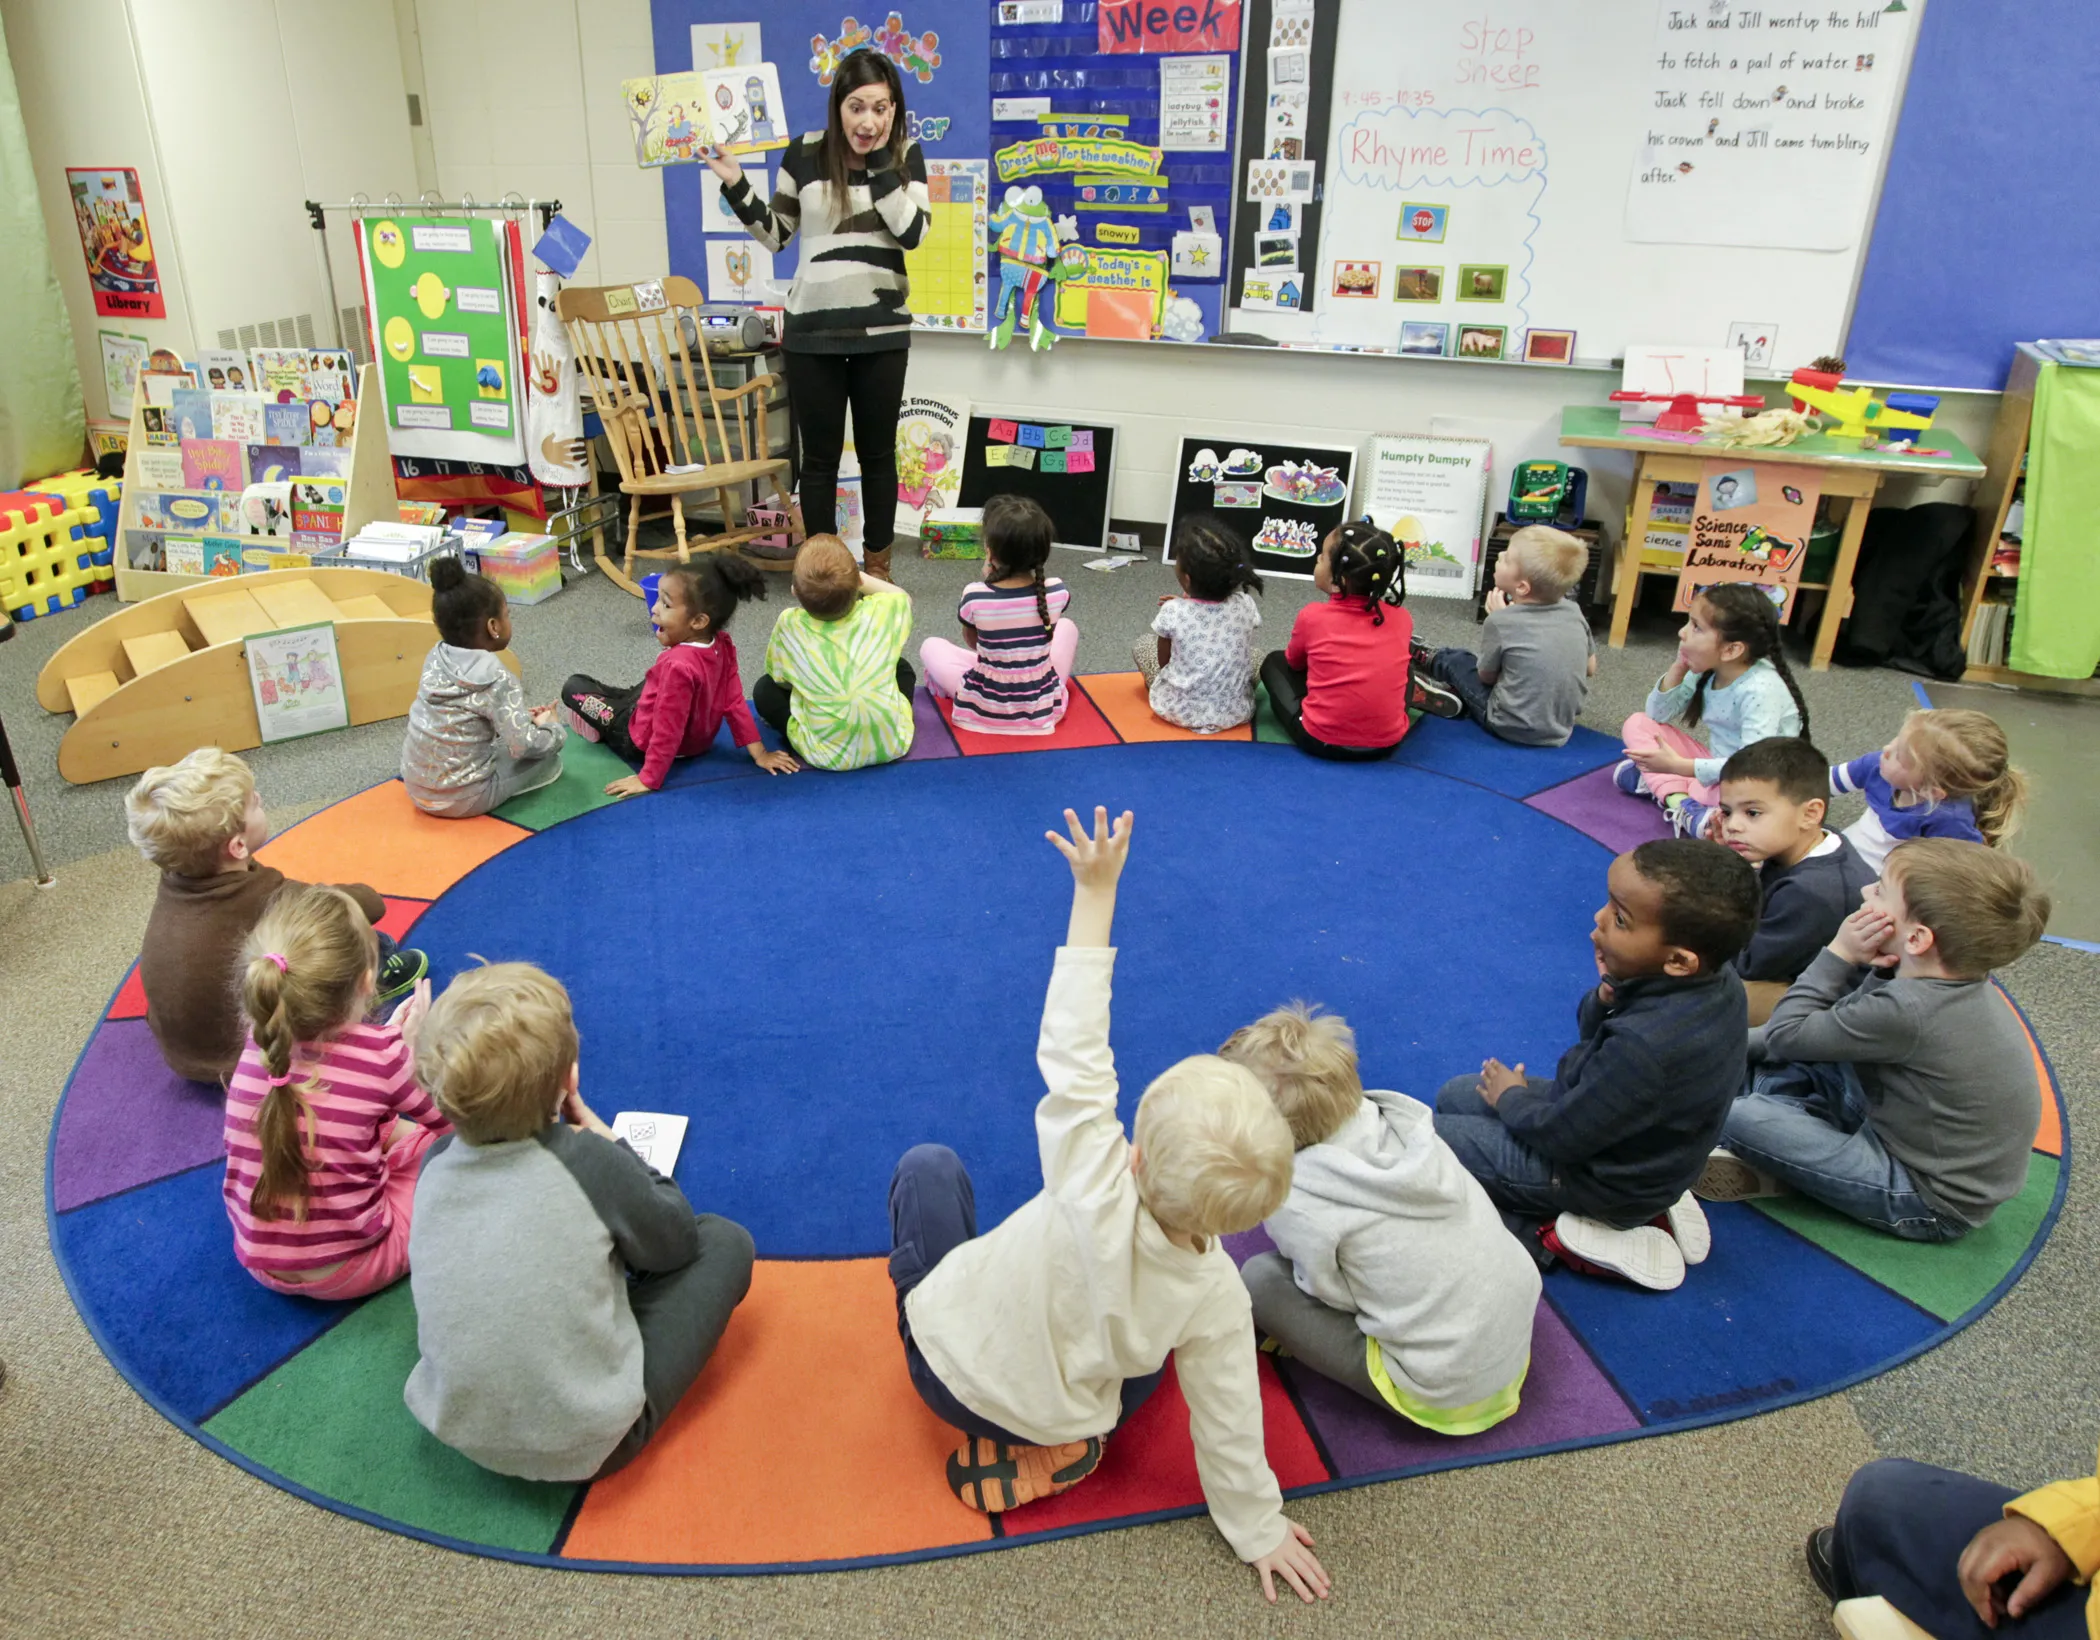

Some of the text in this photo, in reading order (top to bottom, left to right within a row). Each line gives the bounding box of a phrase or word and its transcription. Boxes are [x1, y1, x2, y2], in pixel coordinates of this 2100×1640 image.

[1105, 0, 1226, 43] Week
[1668, 11, 1881, 32] Jack and Jill went up the hill
[1460, 15, 1534, 59] Stop
[1455, 57, 1540, 87] Sheep
[1657, 52, 1676, 69] to
[1684, 51, 1720, 70] fetch
[1729, 58, 1738, 69] a
[1746, 52, 1772, 74] pail
[1779, 51, 1798, 69] of
[1655, 90, 1864, 109] Jack fell down and broke
[1648, 130, 1870, 155] his crown and Jill came tumbling
[1001, 141, 1157, 175] Dress me for the weather!
[1352, 128, 1537, 180] Rhyme Time
[1412, 215, 1434, 227] STOP
[1097, 257, 1140, 275] Today's
[1087, 273, 1151, 287] weather is
[105, 294, 150, 313] Library
[608, 294, 633, 309] Chair
[313, 379, 339, 391] Word
[541, 370, 558, 394] 5
[910, 397, 960, 420] Enormous
[1023, 428, 1041, 441] Bb
[401, 459, 420, 477] 16
[434, 460, 449, 474] 17
[466, 461, 484, 475] 18
[1012, 448, 1030, 462] Ff
[1044, 454, 1065, 471] Gg
[1381, 450, 1471, 467] Humpty Dumpty
[296, 514, 344, 530] SPANIH
[1695, 516, 1748, 534] Science
[204, 539, 222, 547] Mother
[1644, 535, 1682, 548] cience
[1695, 533, 1732, 548] Sam's
[1686, 549, 1768, 576] Laboratory
